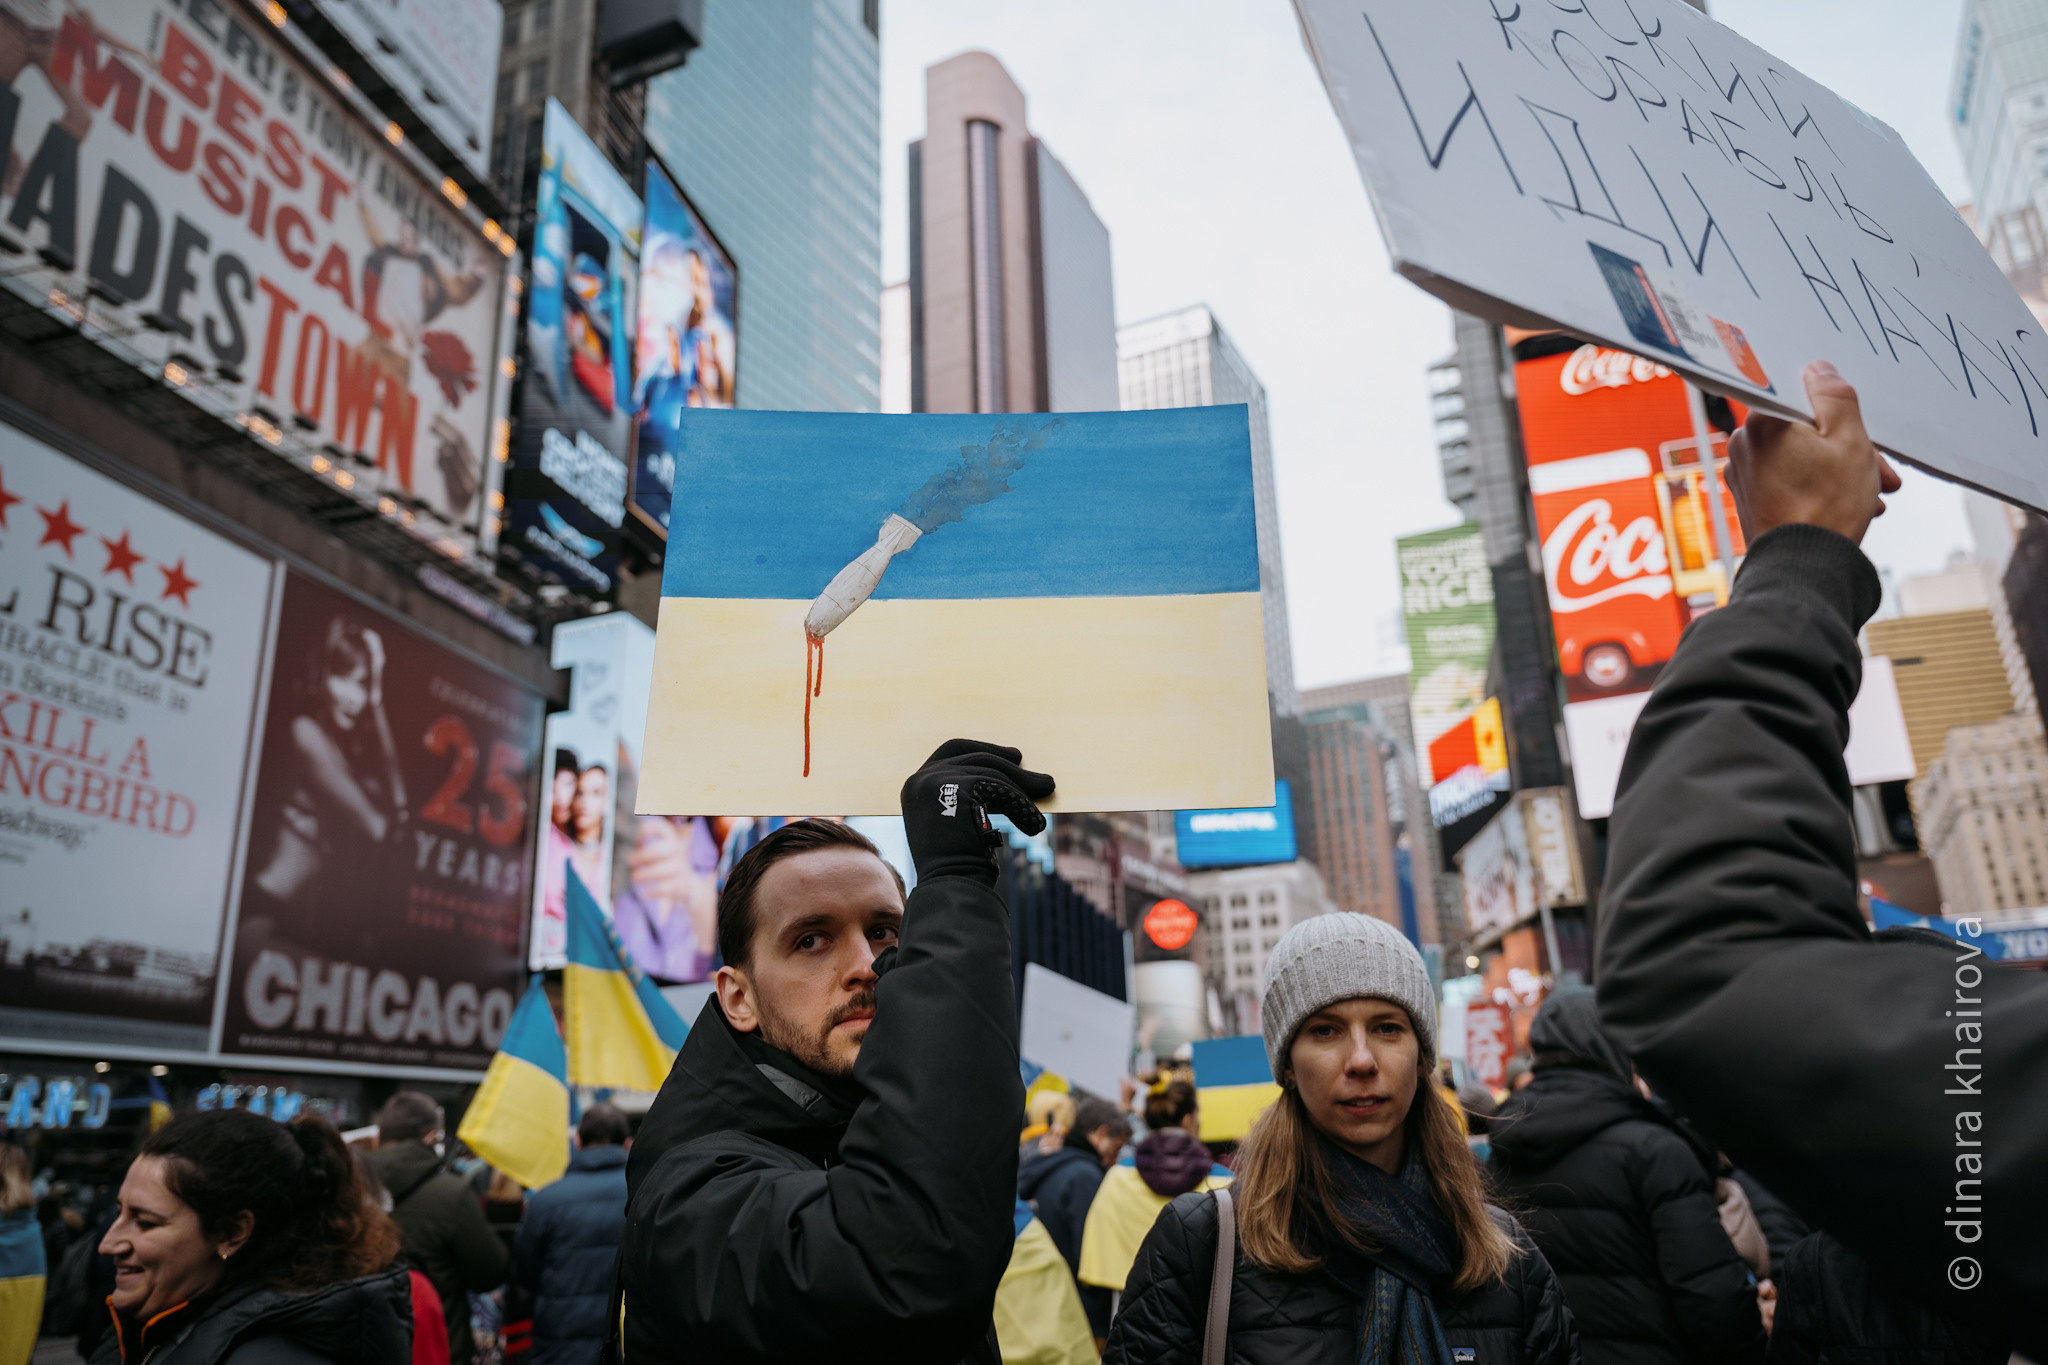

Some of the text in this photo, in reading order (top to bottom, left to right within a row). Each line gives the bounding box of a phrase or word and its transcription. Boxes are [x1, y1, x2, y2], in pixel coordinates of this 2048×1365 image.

[170, 0, 275, 93] ER!
[1548, 0, 1846, 168] СКИЙ
[51, 12, 393, 343] MUSICAL
[158, 19, 352, 225] BEST
[1362, 11, 1761, 300] ИДИ
[36, 562, 215, 690] RISE
[1405, 570, 1495, 616] RICE
[117, 733, 152, 781] A
[419, 715, 528, 848] 25
[944, 783, 955, 806] REI
[414, 829, 522, 897] YEARS
[242, 948, 514, 1051] CHICAGO
